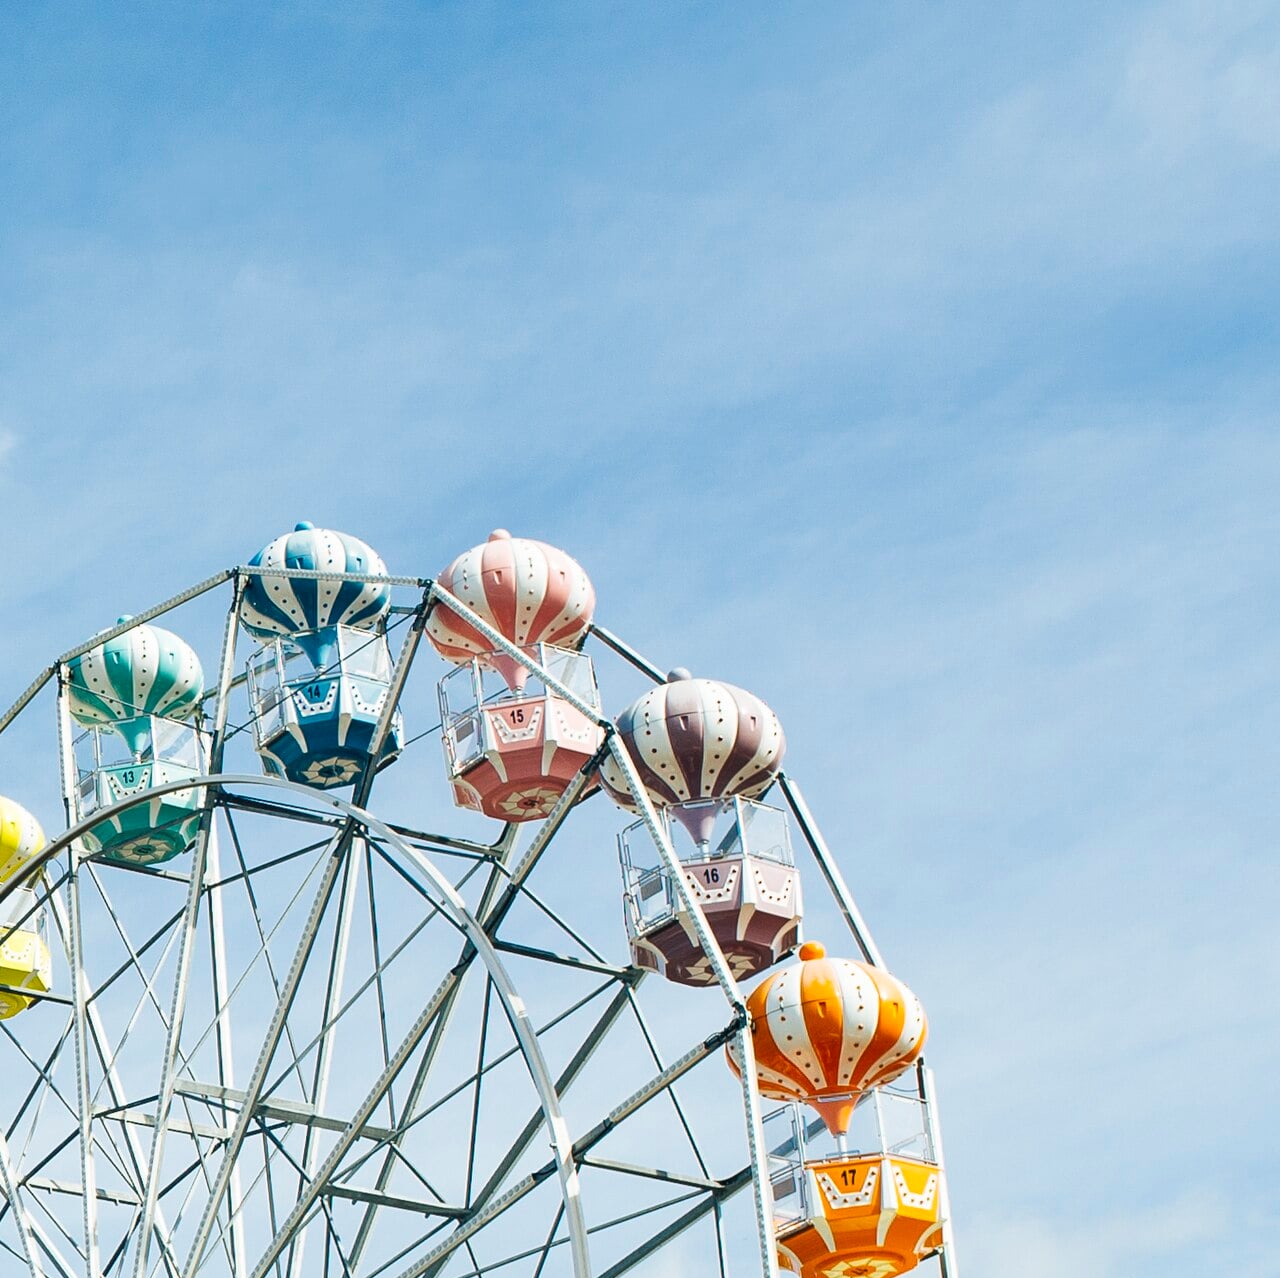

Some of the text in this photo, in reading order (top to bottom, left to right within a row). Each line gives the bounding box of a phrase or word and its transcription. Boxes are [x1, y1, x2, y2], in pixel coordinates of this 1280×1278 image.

[307, 684, 320, 699] 14
[510, 709, 524, 724] 15
[122, 770, 135, 784] 13
[703, 868, 719, 884] 16
[841, 1169, 856, 1186] 17
